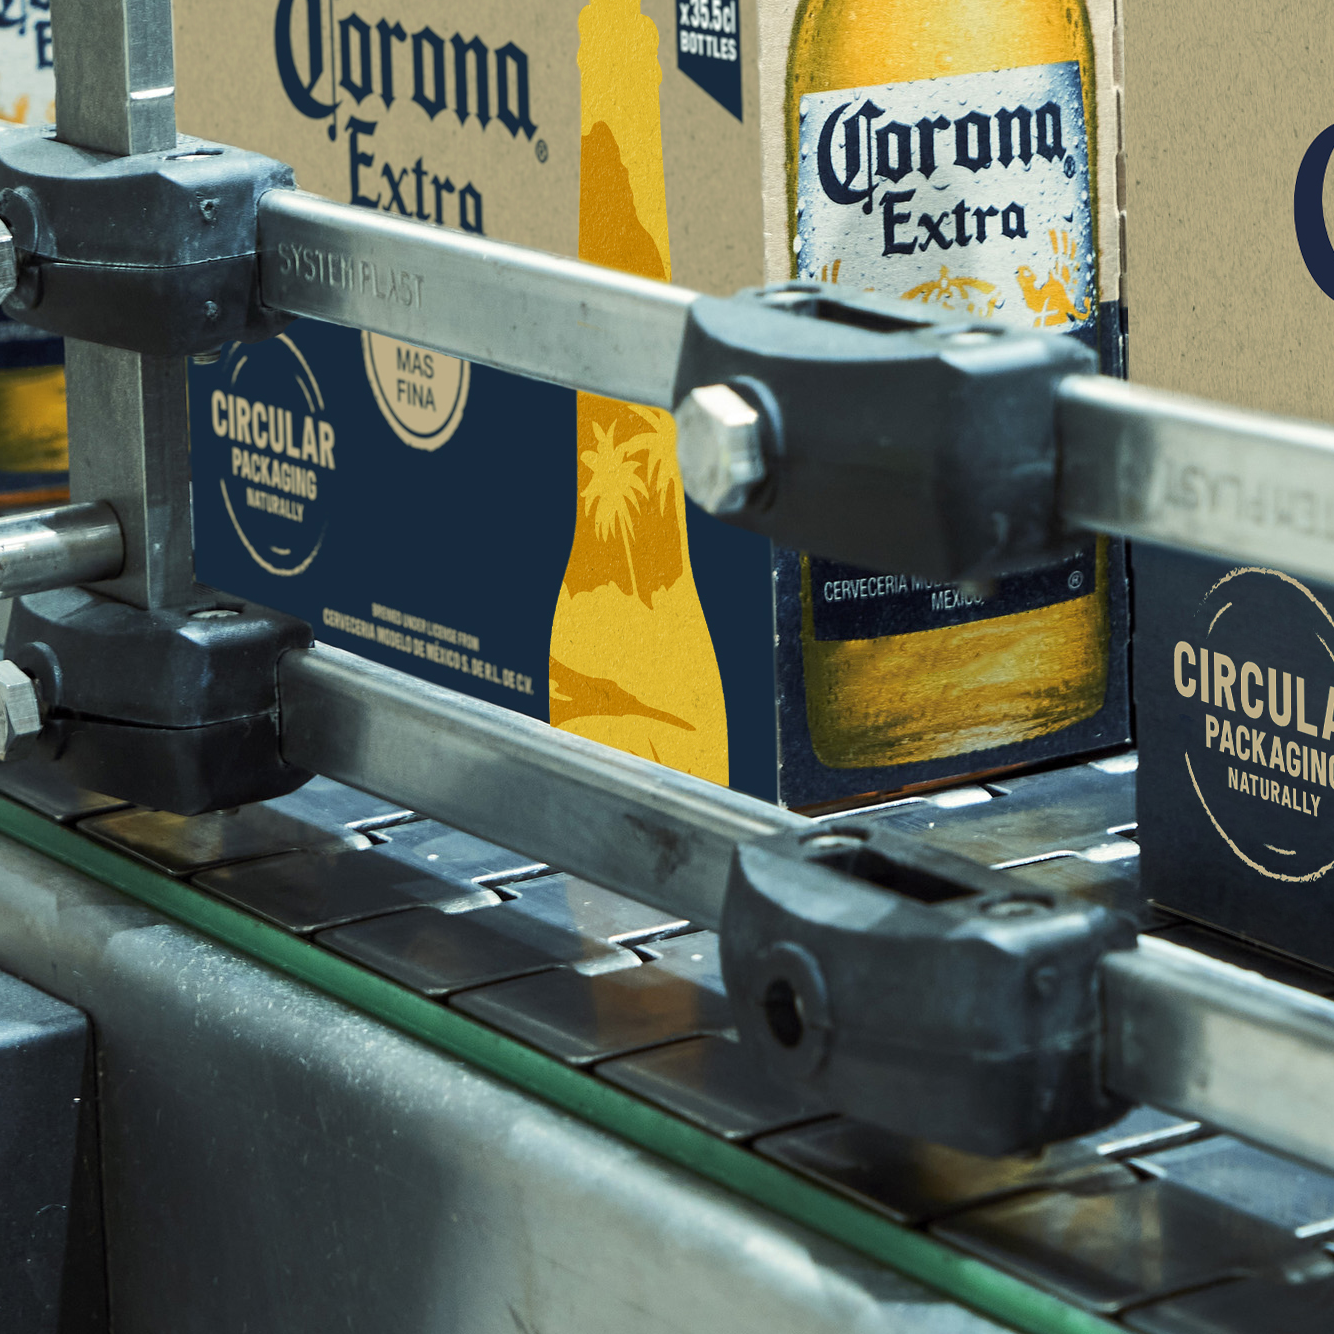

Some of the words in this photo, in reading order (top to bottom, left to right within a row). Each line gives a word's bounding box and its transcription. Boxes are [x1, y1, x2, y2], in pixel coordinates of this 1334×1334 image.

[679, 29, 738, 62] BOTTLES
[344, 114, 488, 237] Extra
[817, 97, 1068, 216] Corona
[879, 188, 1029, 257] Extra
[278, 242, 355, 291] SYSTEM
[359, 260, 425, 311] PLAST
[396, 346, 435, 379] MAS
[396, 378, 437, 413] FINA
[211, 388, 336, 471] CIRCULAR
[231, 445, 318, 502] PACKAGING
[246, 486, 305, 523] NATURALLY
[823, 573, 908, 604] CERVECERIA
[1227, 765, 1322, 818] NATURALLY
